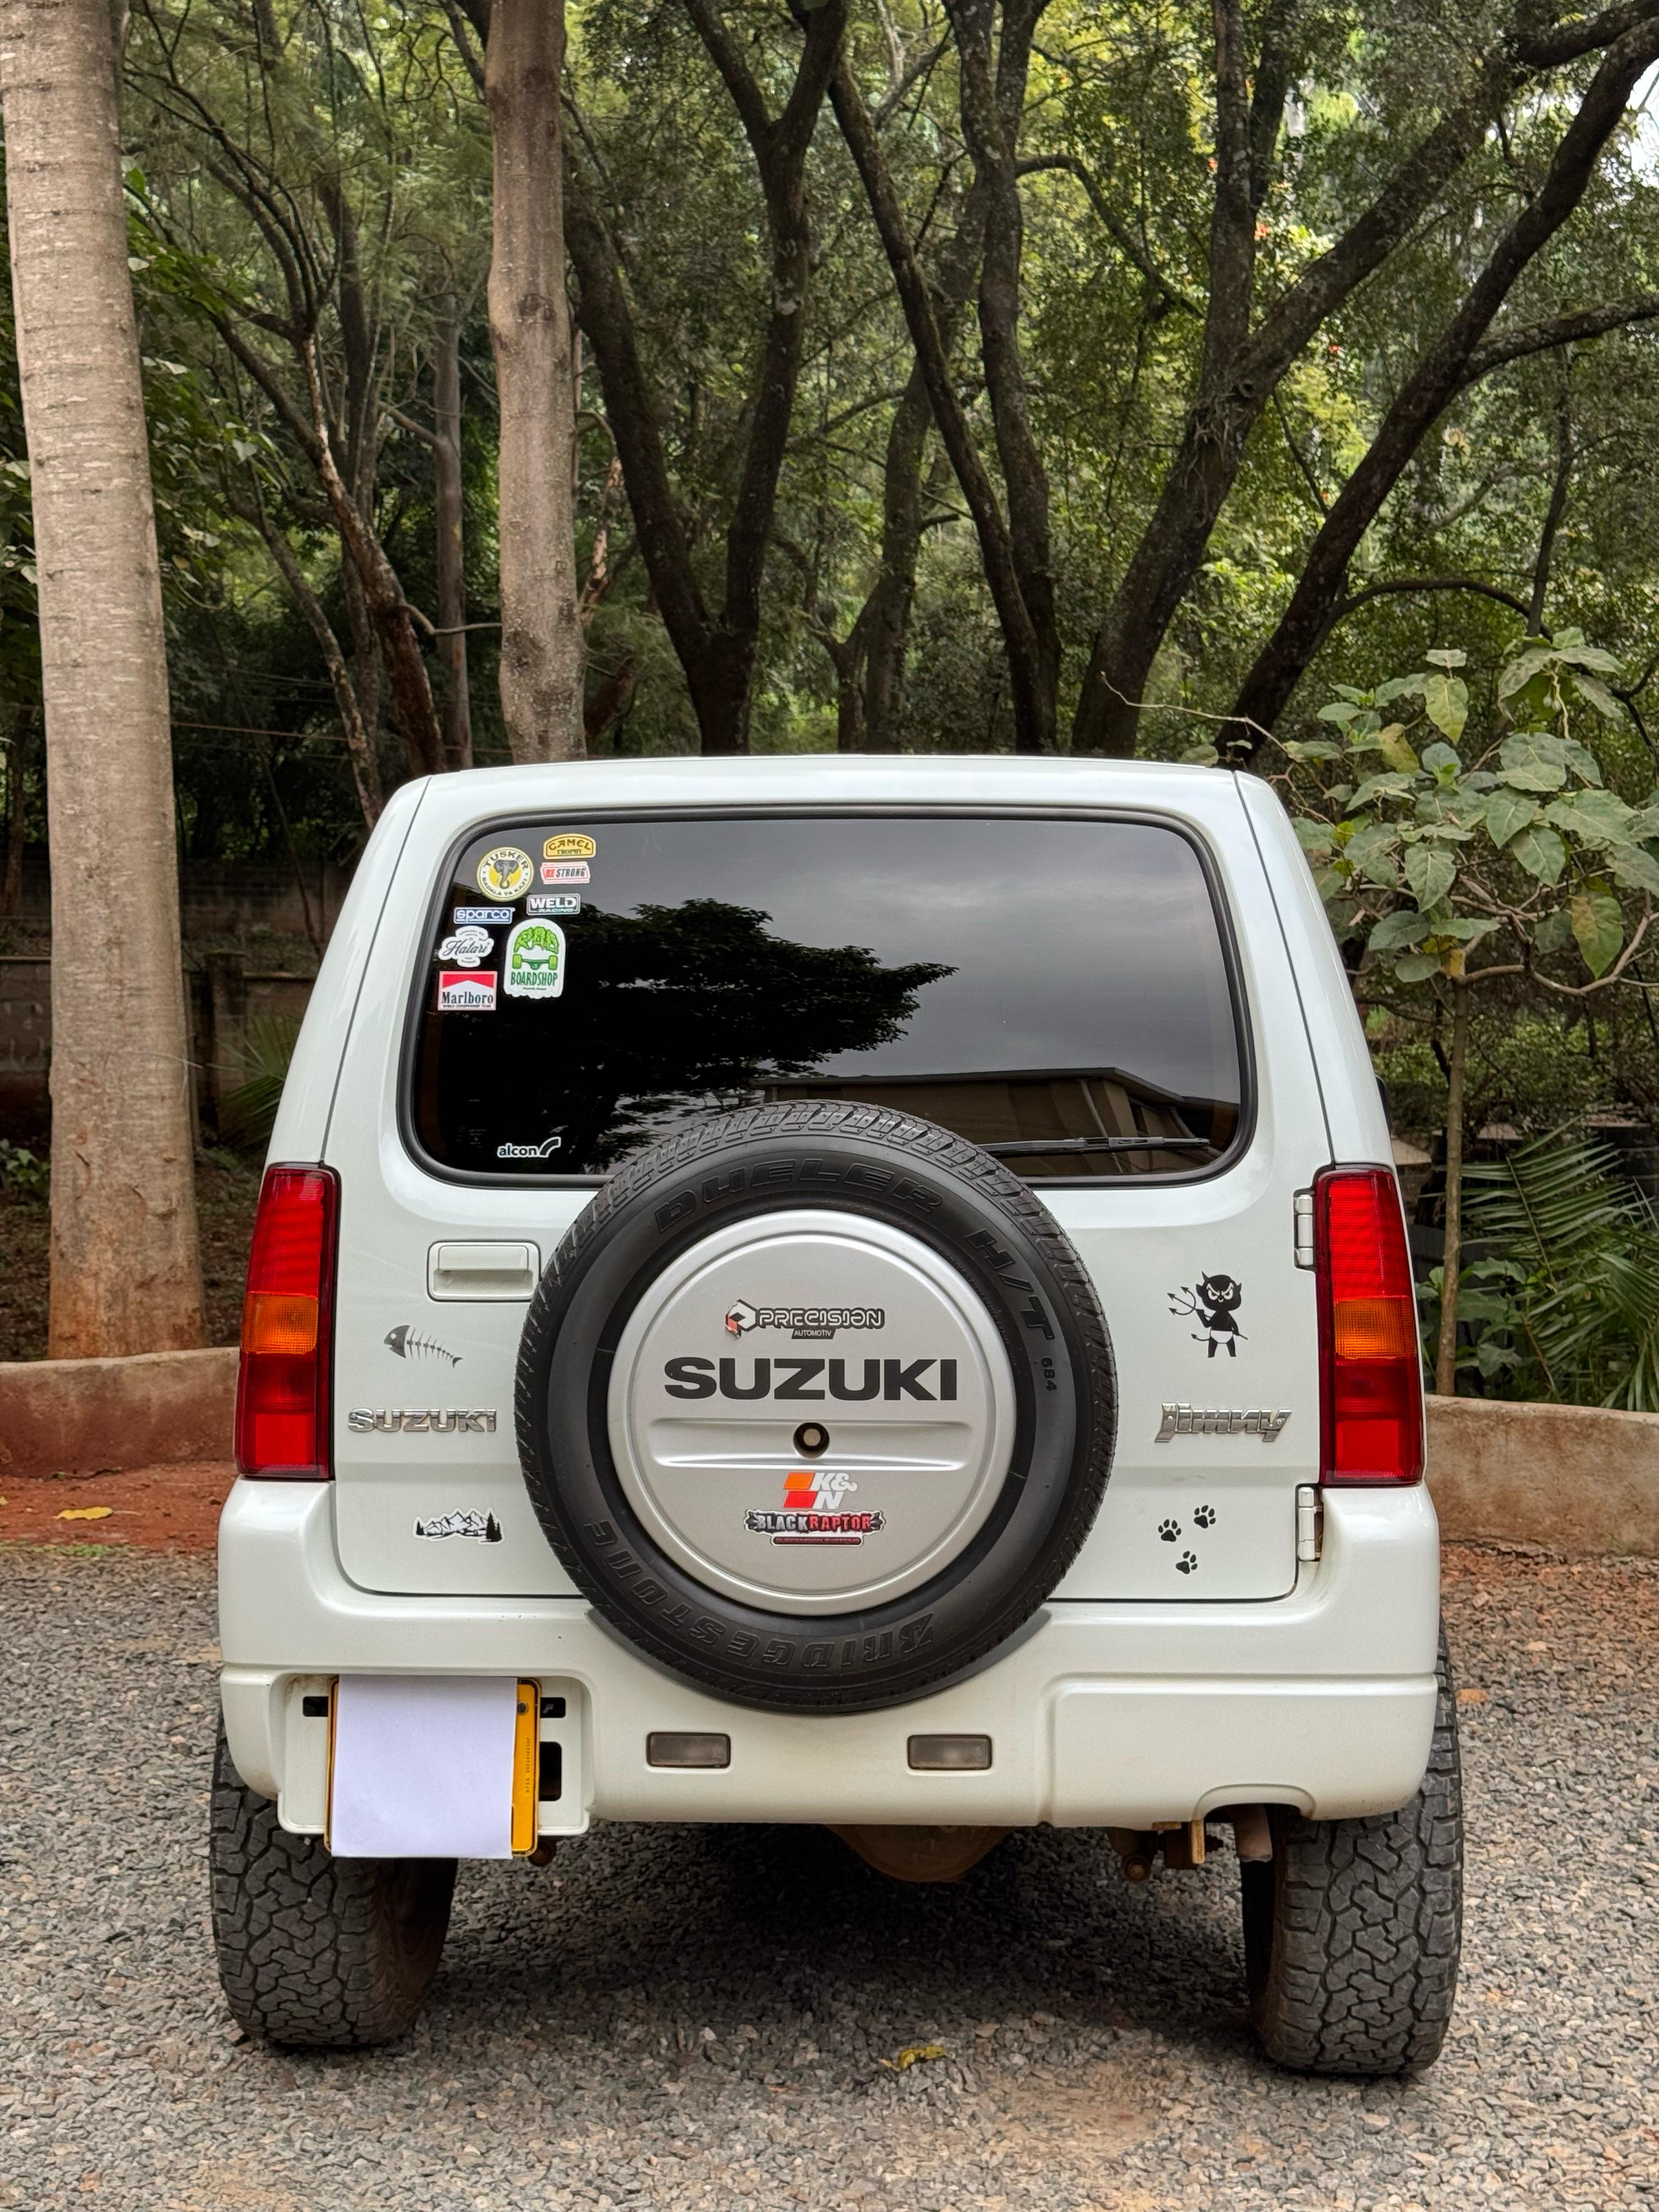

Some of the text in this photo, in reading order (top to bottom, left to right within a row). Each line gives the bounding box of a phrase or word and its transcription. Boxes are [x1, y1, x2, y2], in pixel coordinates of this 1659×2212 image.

[549, 839, 591, 850] CAMEL
[483, 851, 528, 870] TUSKER
[556, 868, 585, 878] STRONG
[482, 877, 502, 896] BADALA
[514, 878, 528, 893] KAZI
[531, 897, 577, 909] WELD
[456, 910, 510, 922] sparco
[442, 939, 490, 957] Hatari
[514, 926, 560, 955] RAD
[511, 972, 558, 986] BOARDSHOP
[441, 991, 494, 1004] Marlboro
[499, 1144, 537, 1156] alcon
[654, 1158, 944, 1232] DUELER
[966, 1229, 1055, 1340] H/T
[759, 1311, 881, 1326] PRECISION
[664, 1357, 957, 1401] SUZUKI
[347, 1408, 497, 1433] SUZUKI
[1153, 1402, 1292, 1443] Jimny
[582, 1519, 934, 1668] BRIDGESTONE
